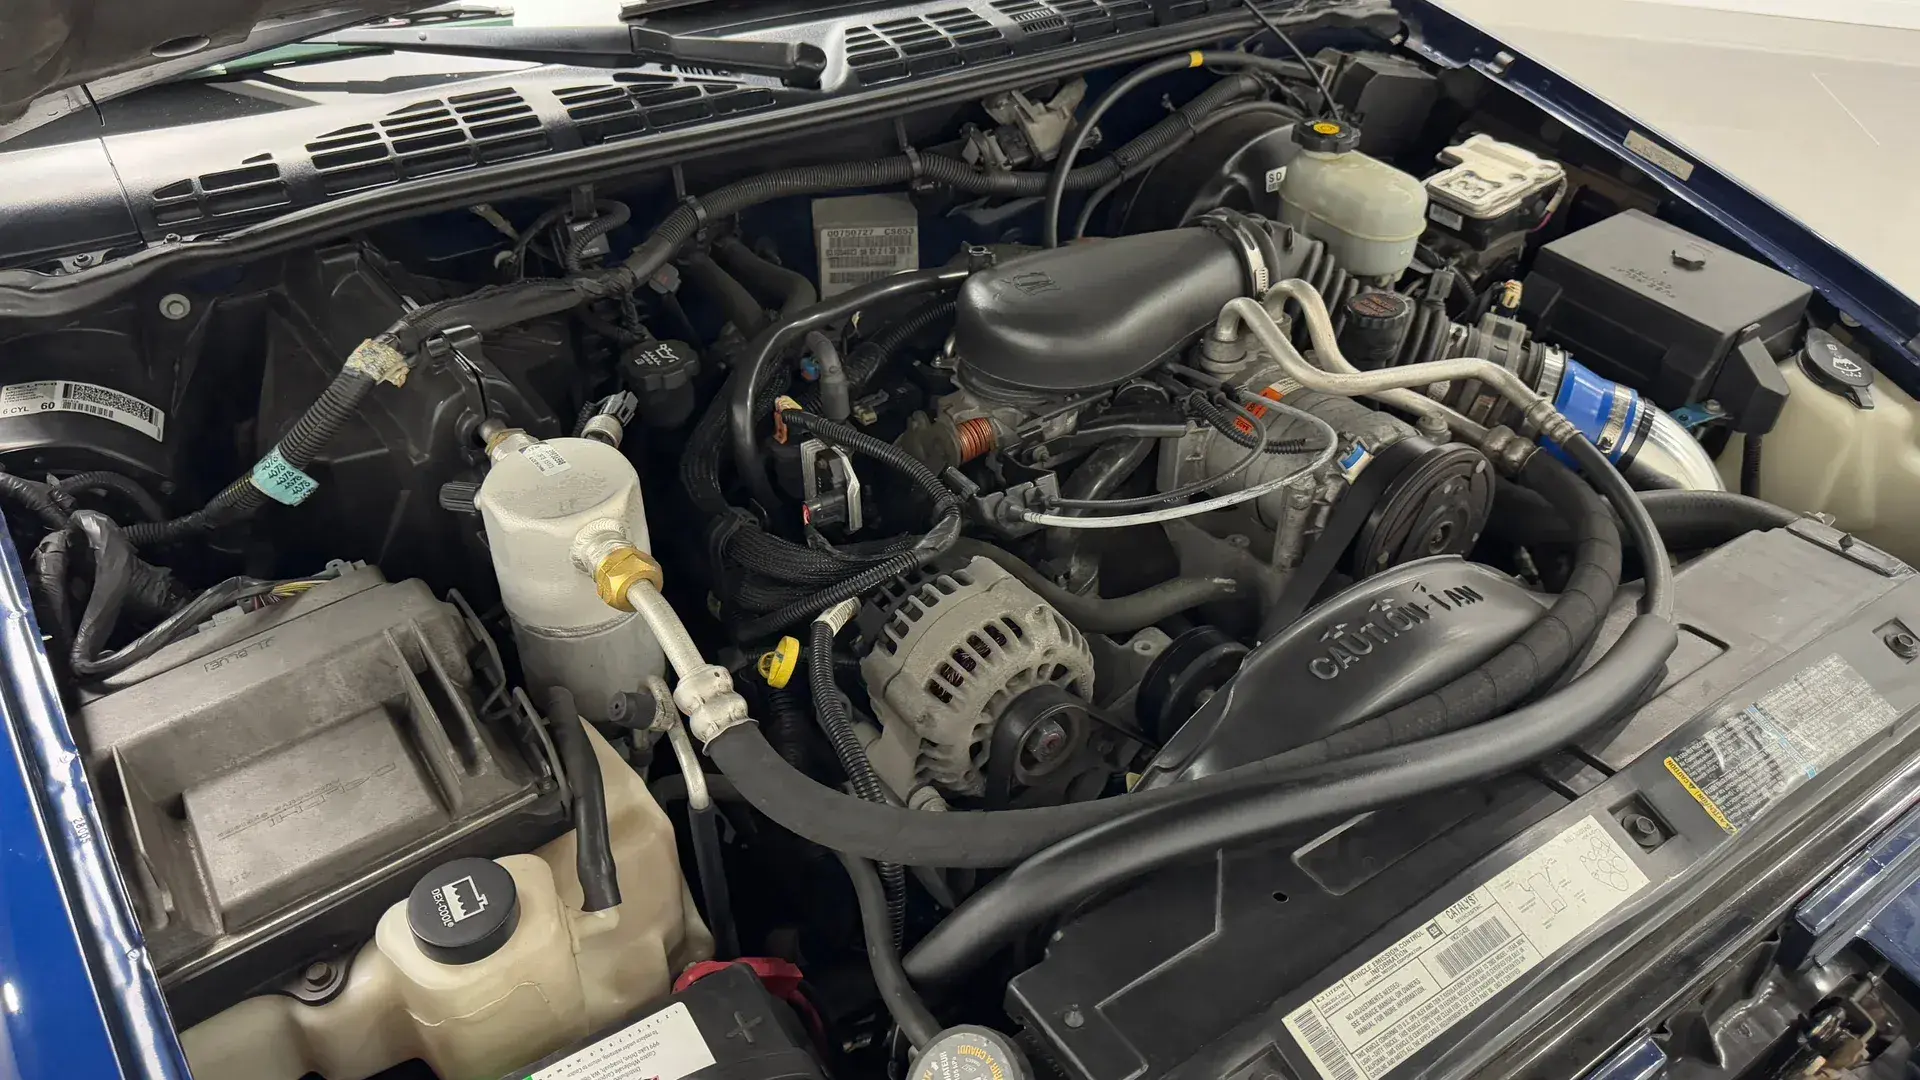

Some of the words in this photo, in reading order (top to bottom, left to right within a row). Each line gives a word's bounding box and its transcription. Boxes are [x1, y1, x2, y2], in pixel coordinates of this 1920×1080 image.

[10, 405, 29, 413] CYL
[40, 401, 55, 409] 60
[1666, 759, 1689, 784] CAUTION
[1444, 892, 1480, 920] CATALYST
[1347, 963, 1373, 983] VEHICLE
[1371, 946, 1399, 967] EMISSION
[1397, 929, 1425, 949] CONTROL
[1363, 972, 1382, 986] GENERAL
[1380, 962, 1397, 975] MOTORS
[1396, 945, 1422, 964] CORPORATION
[1369, 947, 1409, 976] INFORMATION
[1315, 995, 1325, 1004] 4.3
[1324, 982, 1344, 997] LITERS
[1344, 1012, 1354, 1021] NO
[1351, 991, 1384, 1017] ADJUSTMENTS
[1381, 979, 1402, 996] NEEDED.
[1350, 1018, 1361, 1029] SEE
[1359, 1006, 1379, 1022] SERVICE
[1376, 994, 1396, 1010] MANUAL
[1393, 989, 1403, 998] OR
[1400, 976, 1421, 994] OWNERS
[1355, 1049, 1366, 1059] THIS
[1363, 1039, 1380, 1053] VEHICLE
[1377, 1026, 1398, 1044] CONFORMS
[1431, 996, 1441, 1005] TIER
[1441, 979, 1465, 998] REGULATIONS
[1463, 966, 1484, 983] APPLICABLE
[1494, 950, 1507, 961] MODEL
[1507, 942, 1518, 952] YEAR
[1355, 1019, 1376, 1036] MANUAL
[1373, 1013, 1385, 1024] FOR
[1382, 1004, 1398, 1018] MORE
[1394, 984, 1427, 1009] INFORMATION.
[1359, 1054, 1372, 1066] LIGHT
[1372, 1046, 1385, 1057] DUTY
[1398, 1029, 1408, 1038] THIS
[1406, 1019, 1421, 1033] VEHICLE
[1419, 1006, 1440, 1023] CONFORMS
[1442, 993, 1458, 1007] FEDERAL
[1456, 978, 1480, 997] REGULATIONS
[1488, 959, 1506, 974] CERTIFIED
[1510, 949, 1521, 958] SALE
[1385, 1047, 1396, 1057] THIS
[1394, 1037, 1409, 1051] VEHICLE
[1411, 1022, 1431, 1039] CERTIFIED
[1440, 1006, 1453, 1018] CLEAN
[1450, 1000, 1461, 1010] FUEL
[1459, 993, 1471, 1004] FLEET
[1474, 976, 1496, 993] STANDARDS
[1493, 969, 1505, 980] WHEN
[1502, 958, 1521, 973] OPERATED
[621, 1040, 636, 1050] under
[635, 1031, 652, 1044] replace
[648, 1040, 659, 1049] 999
[1369, 1062, 1388, 1079] GASOLINE
[1393, 1048, 1407, 1061] MEETS
[1418, 1025, 1440, 1043] APPLICABLE
[1437, 1007, 1465, 1029] REQUIREMENTS
[622, 1051, 637, 1062] Drive,
[637, 1045, 649, 1055] Lake
[639, 1049, 656, 1062] Costco
[957, 1044, 986, 1059] CHAUD!
[587, 1057, 602, 1068] return
[600, 1058, 623, 1073] Issaquah,
[613, 1058, 640, 1074] Wholesale
[566, 1067, 582, 1078] Costco
[589, 1070, 600, 1079] WA
